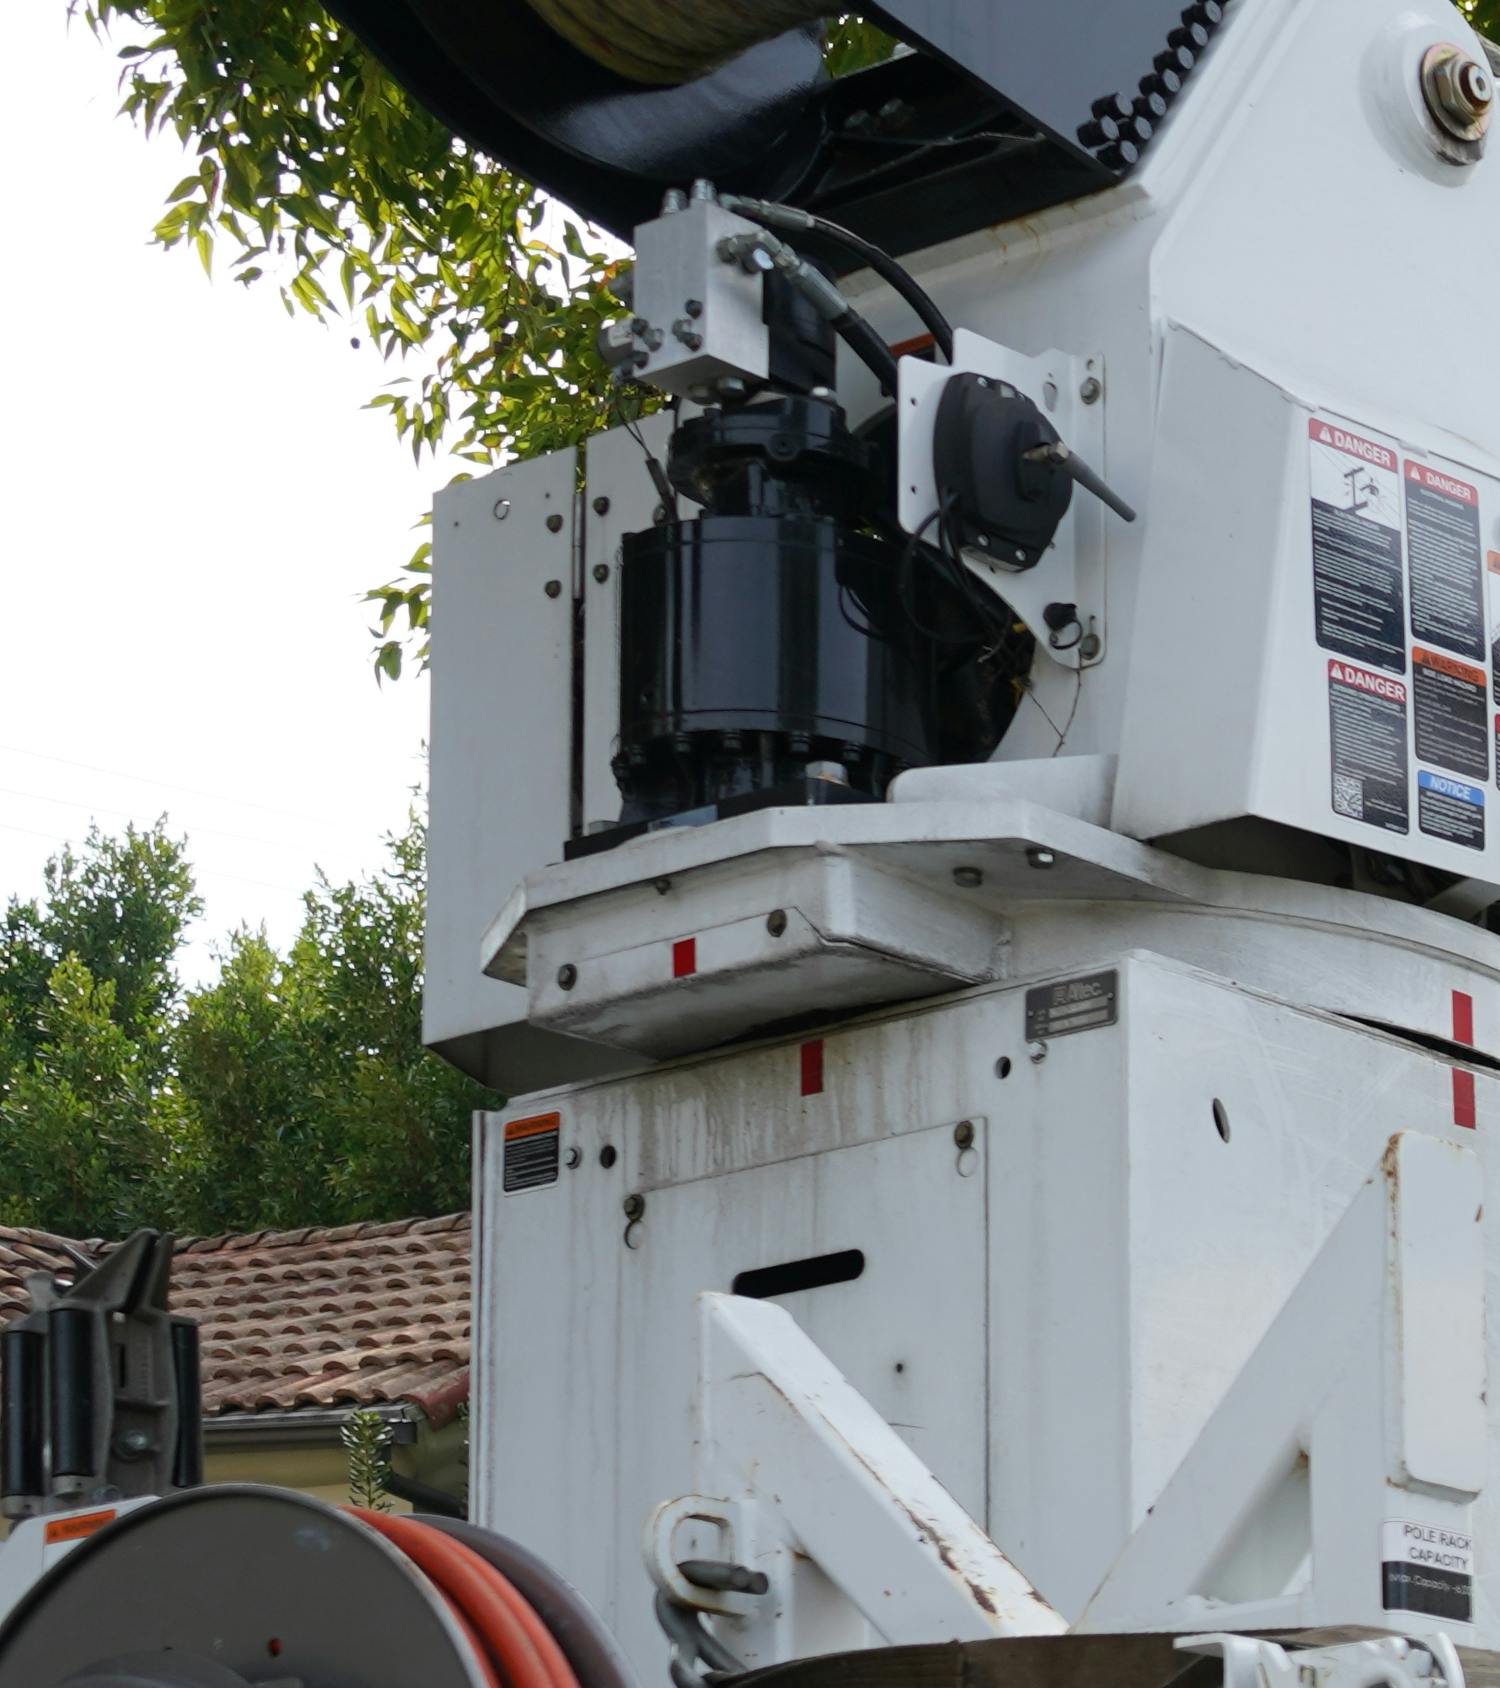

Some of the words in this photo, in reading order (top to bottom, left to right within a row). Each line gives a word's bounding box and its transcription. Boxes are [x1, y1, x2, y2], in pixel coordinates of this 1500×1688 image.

[1334, 430, 1391, 467] DANGER
[1425, 471, 1472, 500] DANGER
[1429, 653, 1480, 682] WARNING
[1345, 668, 1405, 701] DANGER
[1430, 775, 1471, 800] NOTICE
[1404, 1524, 1436, 1543] POLE
[1440, 1533, 1472, 1551] RACK
[1409, 1547, 1469, 1569] CAPACITY
